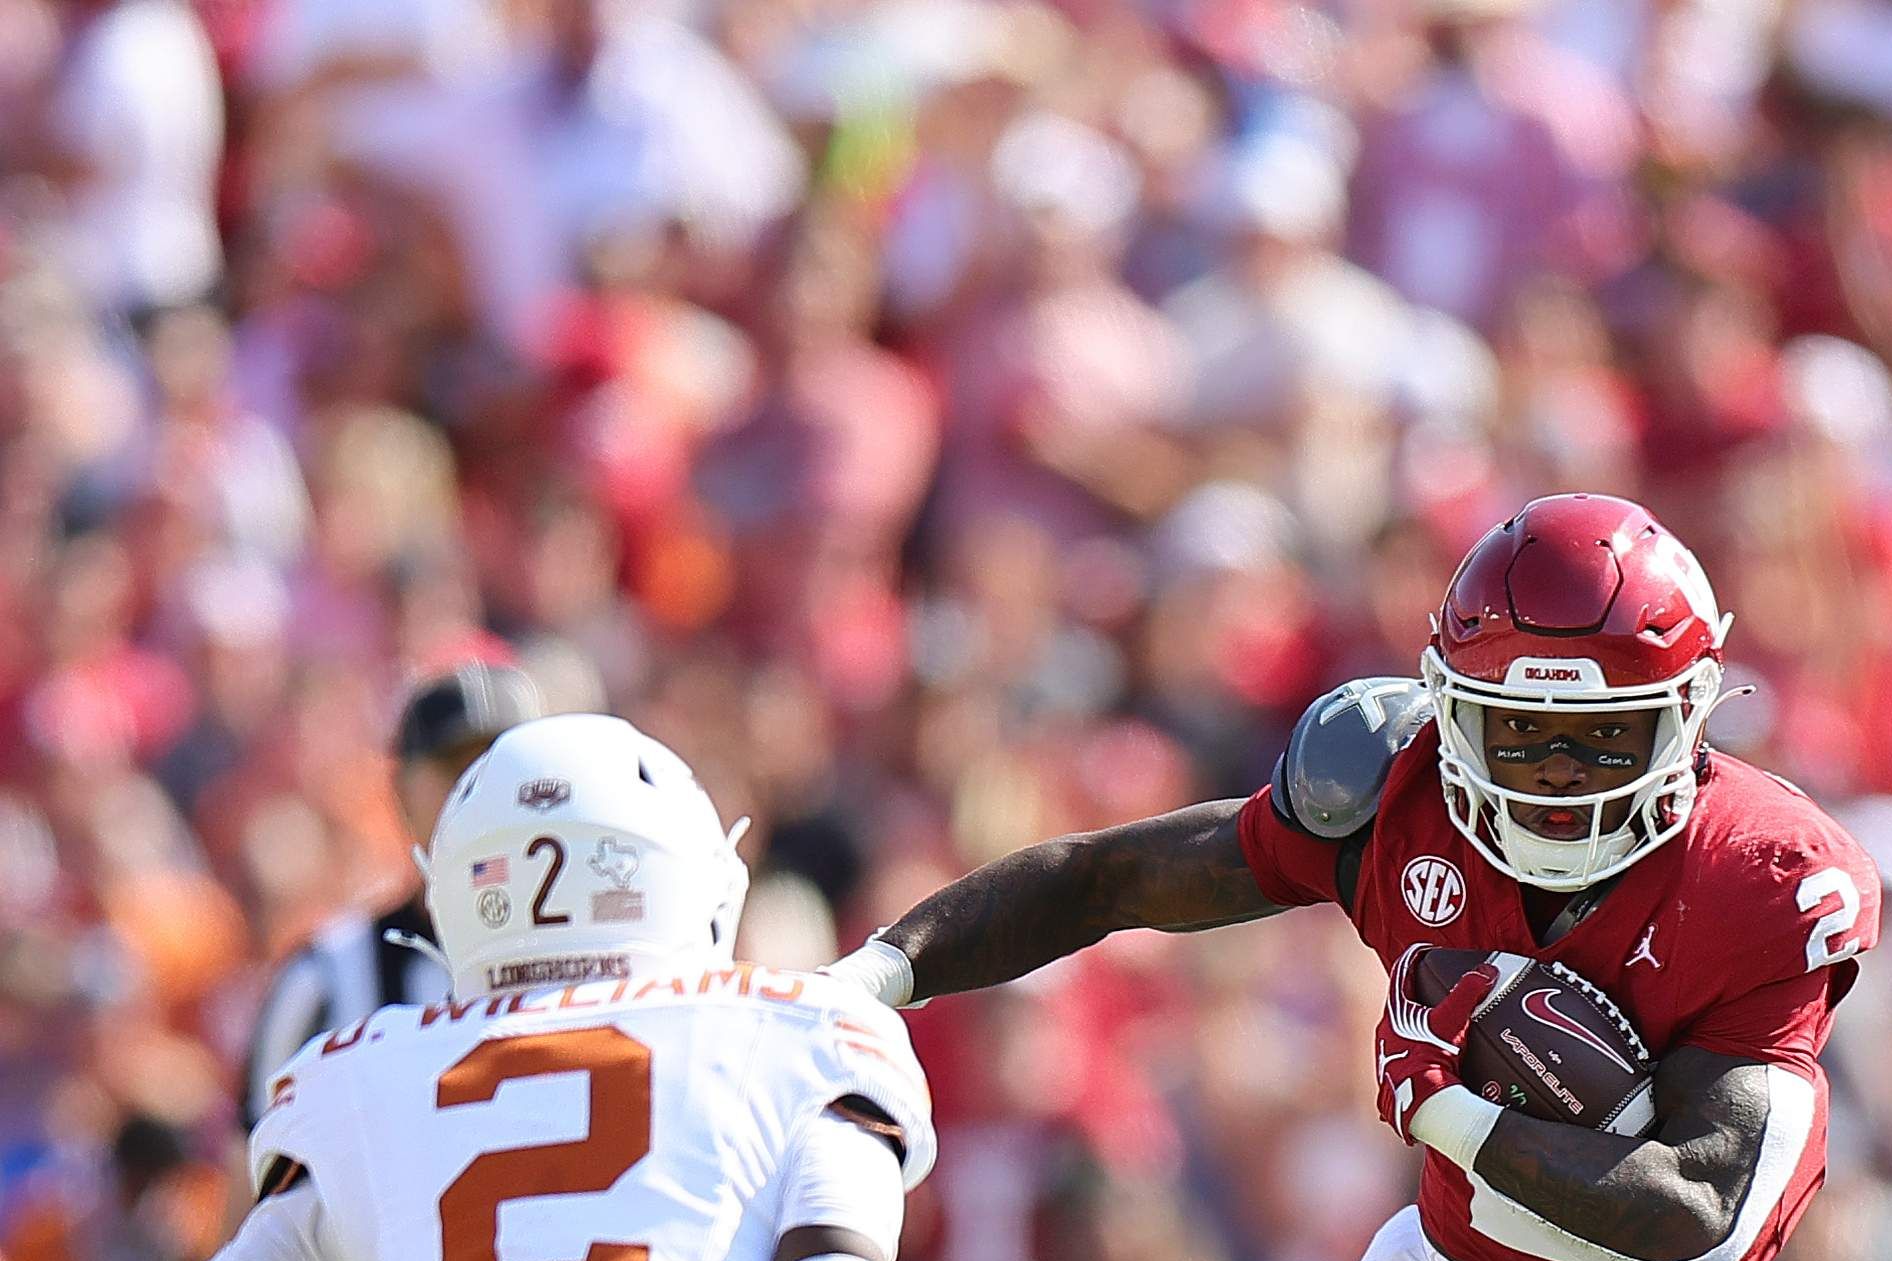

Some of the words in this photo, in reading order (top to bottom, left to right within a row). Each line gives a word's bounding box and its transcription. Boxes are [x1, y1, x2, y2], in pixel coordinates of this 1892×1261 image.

[1525, 667, 1582, 682] OKLAHOMA
[527, 836, 570, 925] 2
[1404, 859, 1462, 923] SEC
[1795, 866, 1860, 974] 2
[1500, 1027, 1548, 1078] VAPOR
[1542, 1071, 1584, 1116] ELITE
